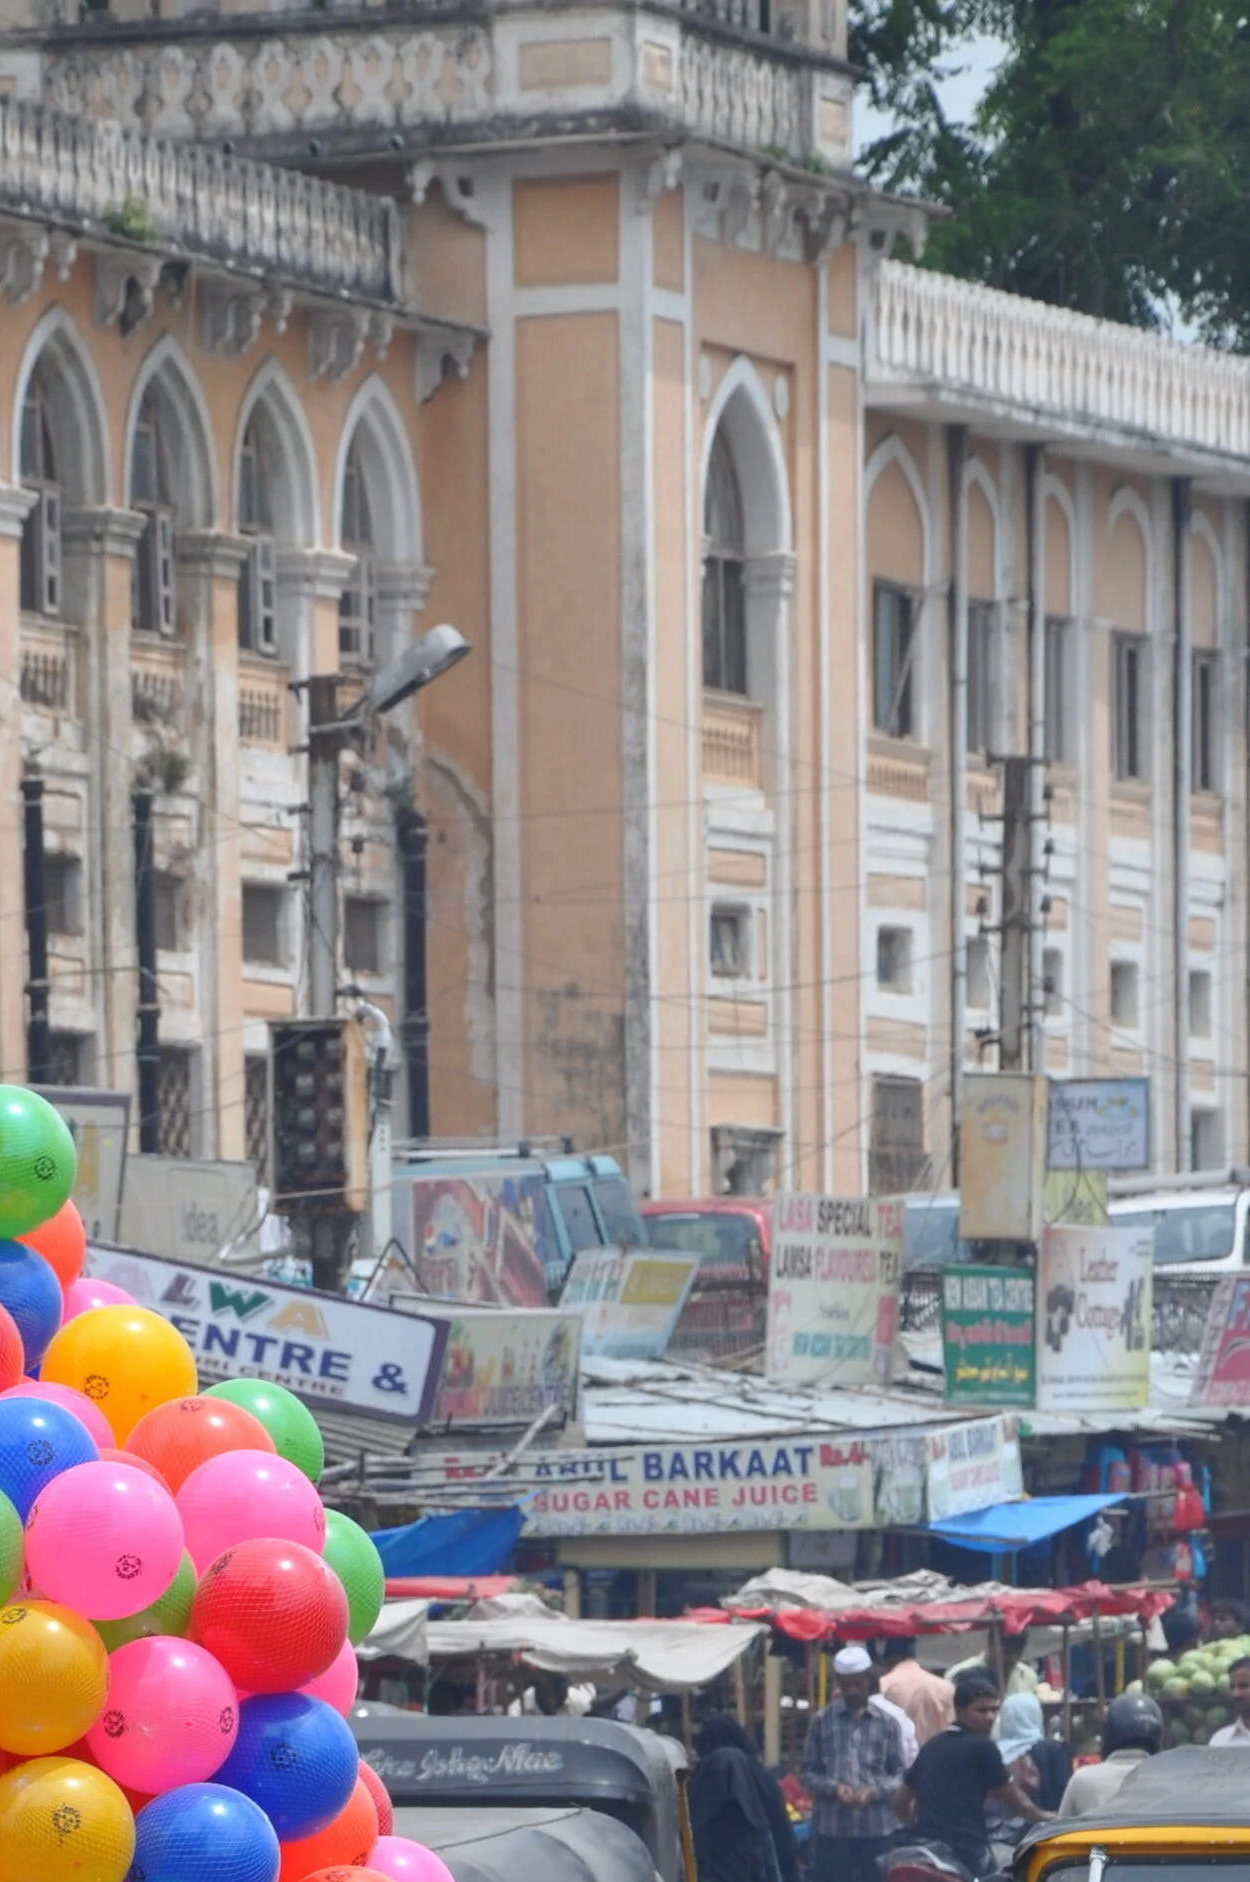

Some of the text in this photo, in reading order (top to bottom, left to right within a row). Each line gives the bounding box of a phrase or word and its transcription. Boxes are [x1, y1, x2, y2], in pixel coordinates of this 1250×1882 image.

[817, 1199, 871, 1237] SPECIAL
[878, 1204, 902, 1238] TEA
[84, 1249, 329, 1341] ALWA
[149, 1308, 409, 1396] ENTRE &
[239, 1364, 346, 1397] CENTRE
[643, 1446, 815, 1483] BARKAAT
[533, 1483, 818, 1514] SUGAR CANE JUICE
